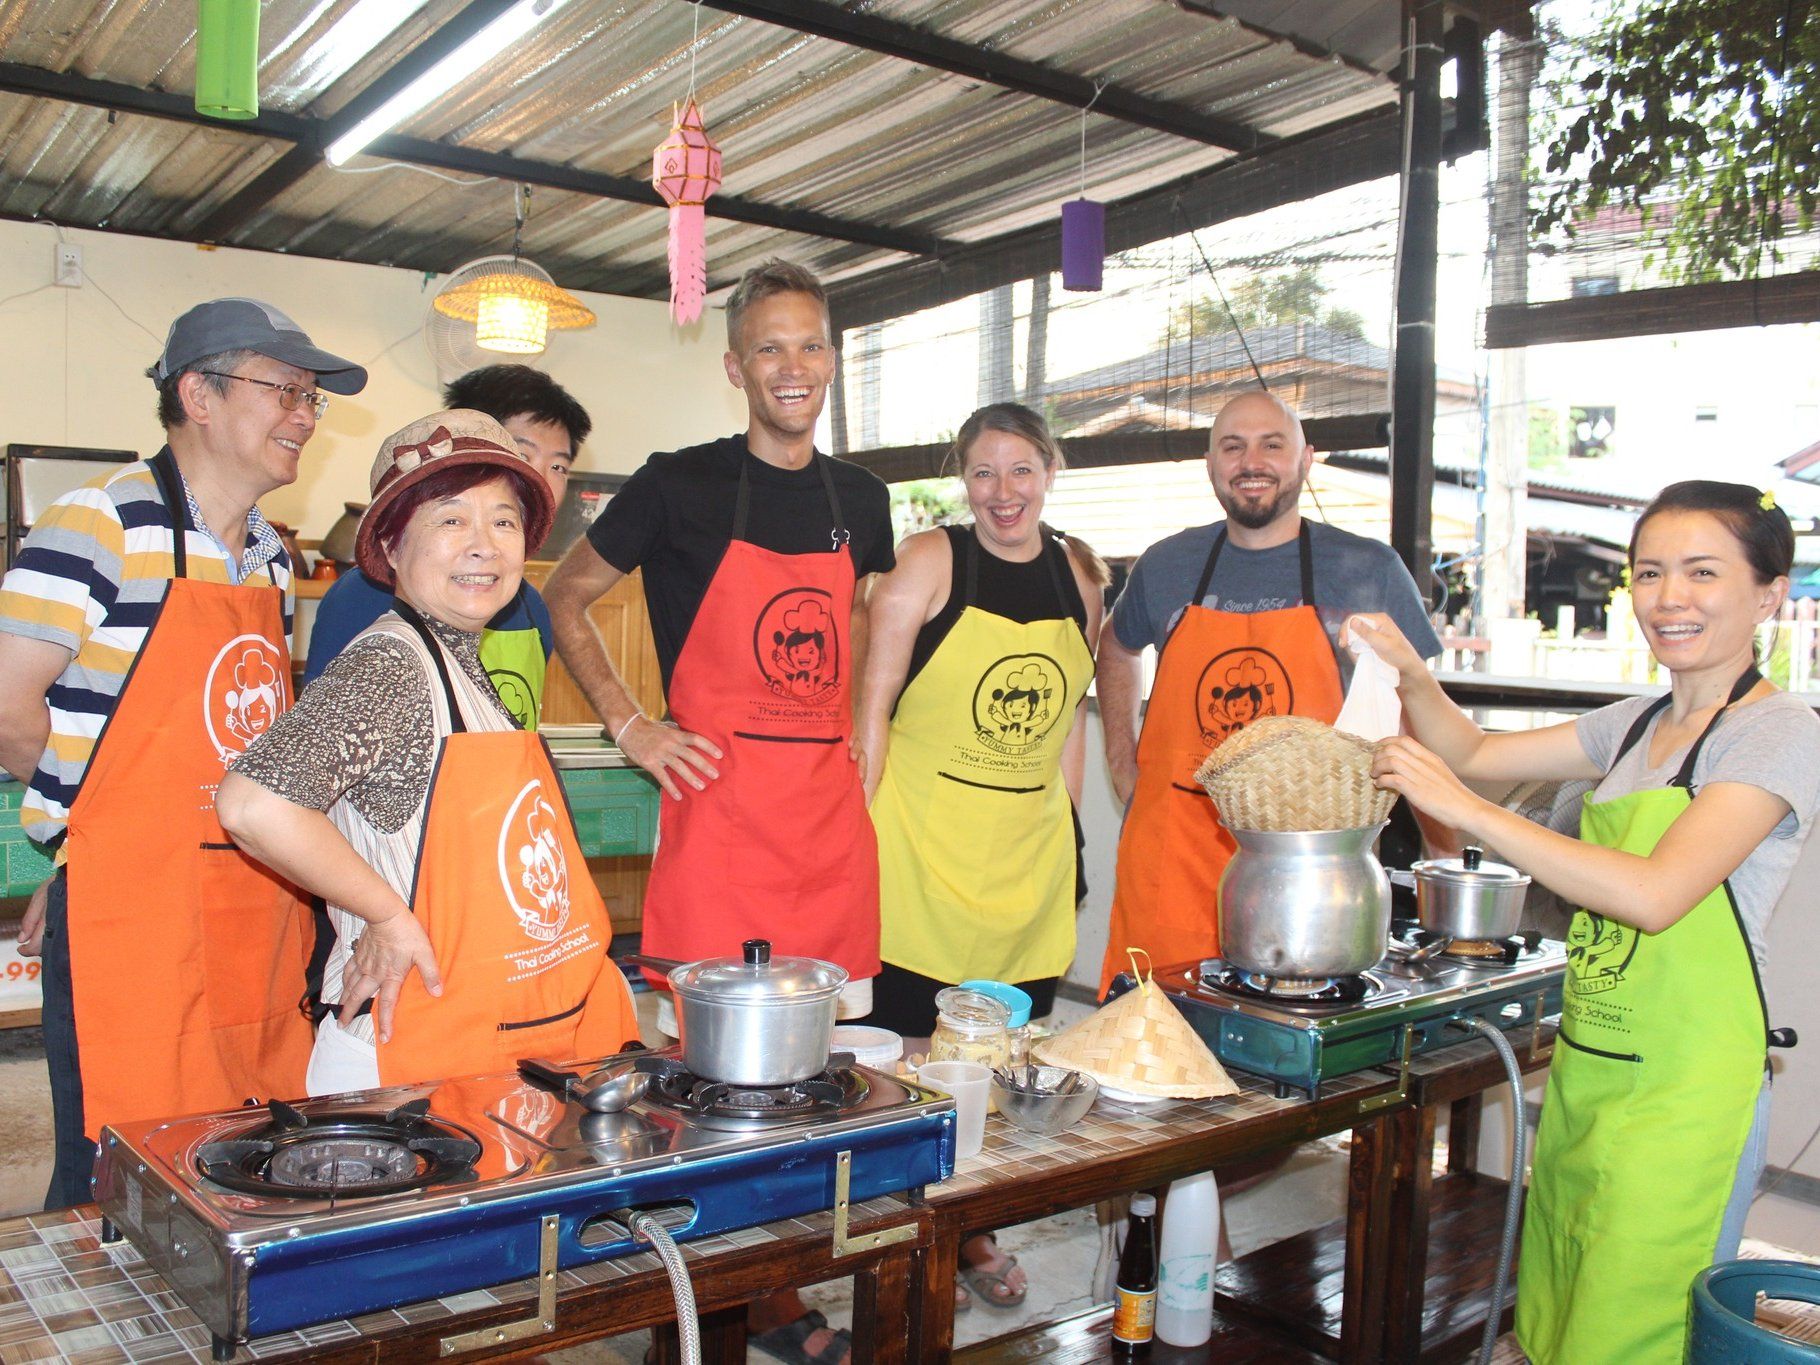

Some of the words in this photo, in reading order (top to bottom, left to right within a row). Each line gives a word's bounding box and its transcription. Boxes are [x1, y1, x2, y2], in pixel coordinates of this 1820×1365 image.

[1224, 599, 1253, 612] Since
[1256, 598, 1287, 611] 1954
[759, 707, 780, 716] Thai
[783, 709, 823, 719] Cooking
[984, 736, 1014, 754] YUMMY
[960, 752, 980, 763] Thai
[983, 757, 1018, 769] Cooking
[514, 956, 537, 970] Thai
[560, 932, 589, 953] School
[1577, 978, 1608, 993] TASTY
[1585, 1005, 1622, 1023] School
